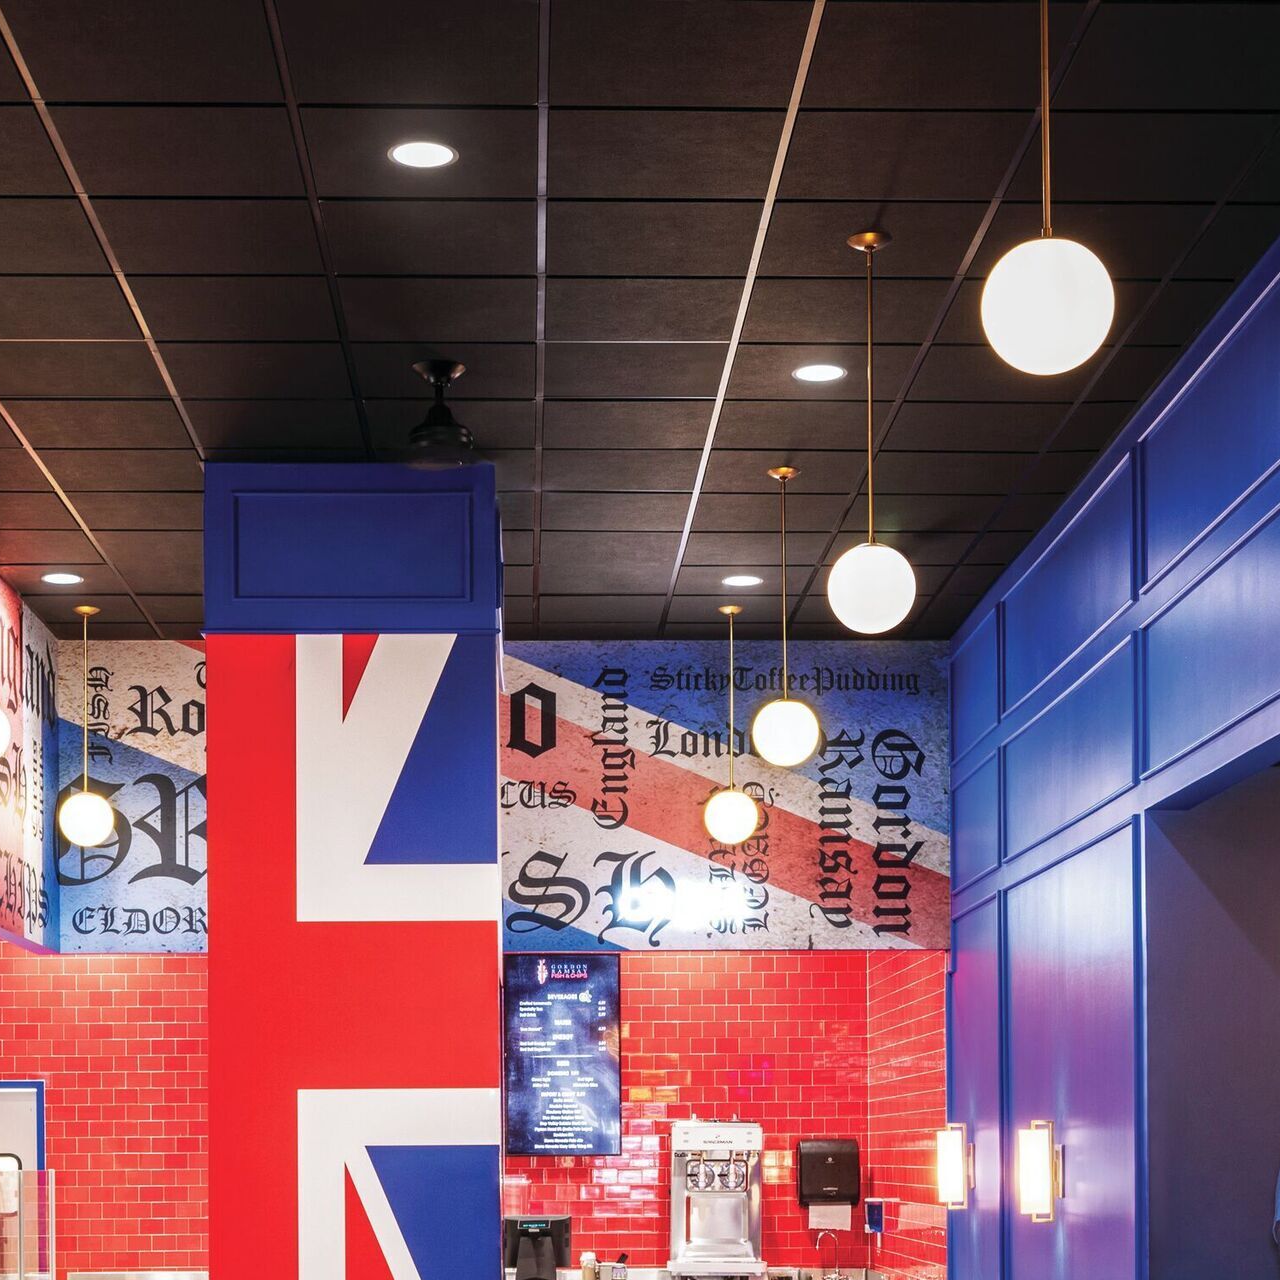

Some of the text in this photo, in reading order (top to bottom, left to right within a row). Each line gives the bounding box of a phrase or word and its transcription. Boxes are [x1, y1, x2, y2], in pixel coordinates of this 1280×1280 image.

[591, 667, 637, 831] England
[645, 716, 754, 758] Lond
[809, 728, 866, 929] Ramsay
[872, 728, 927, 938] Gordon
